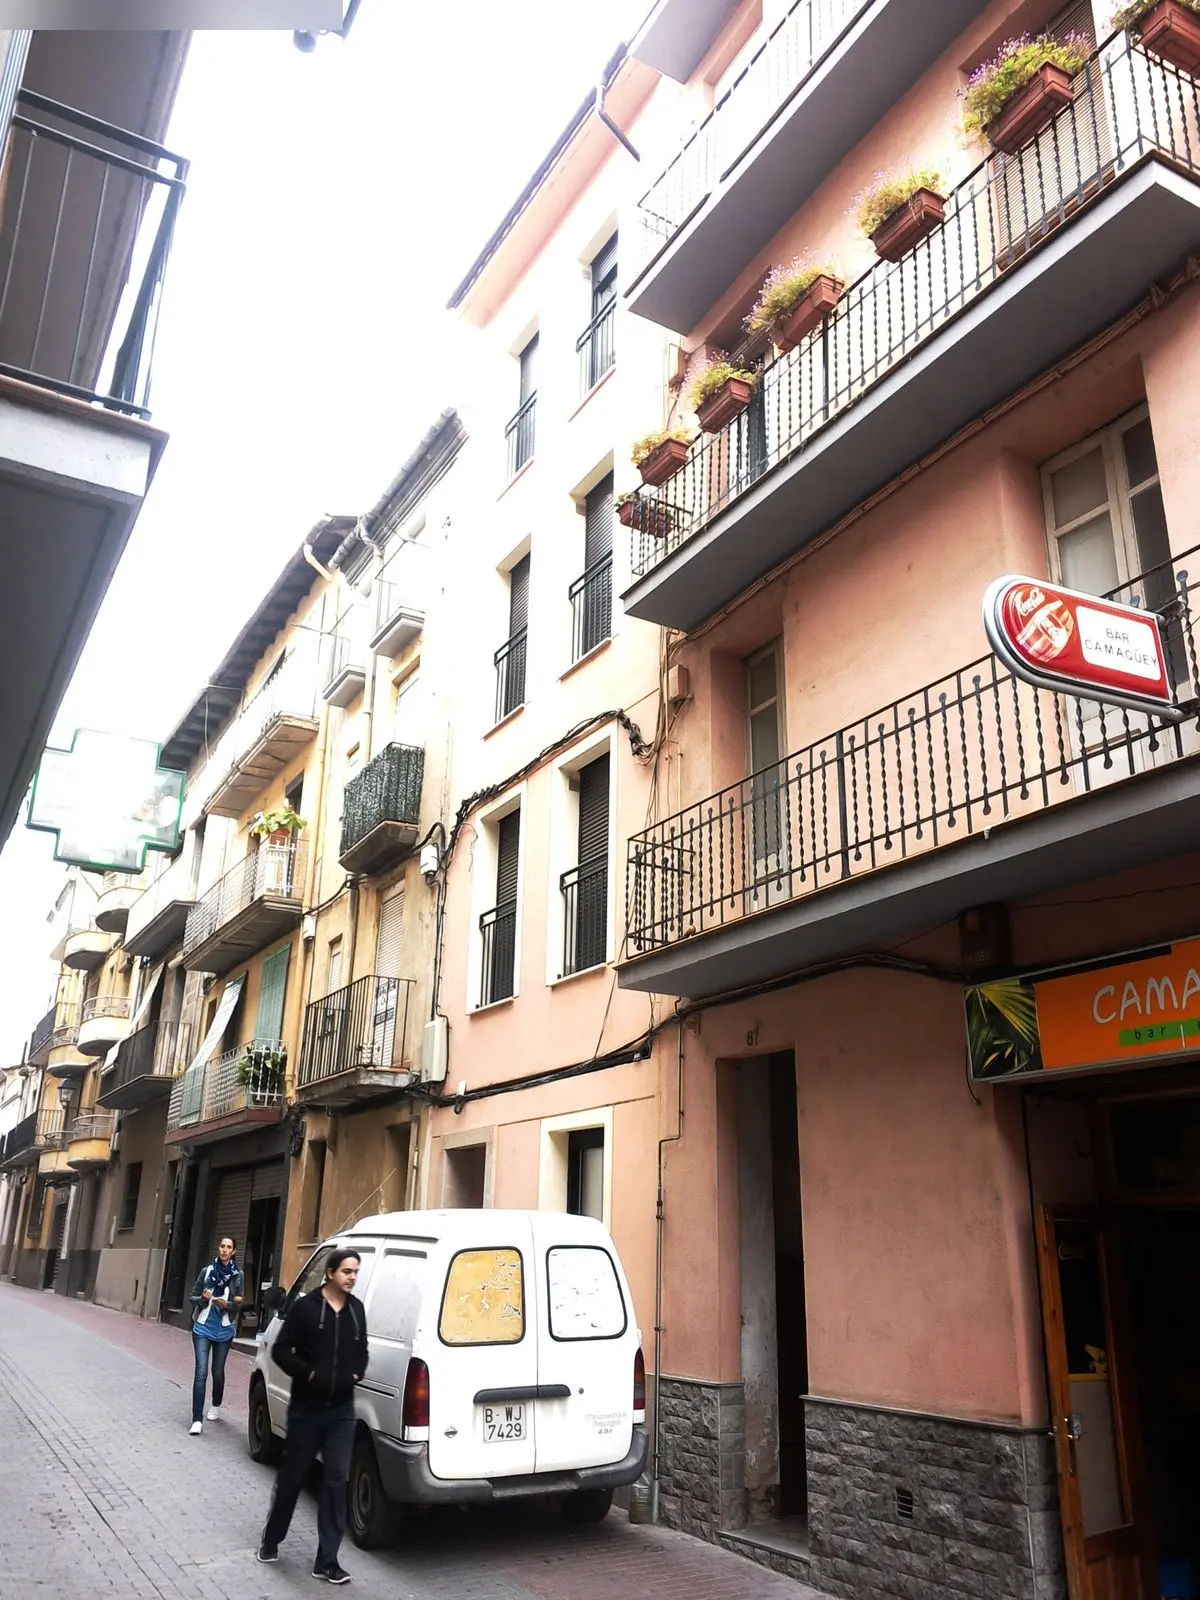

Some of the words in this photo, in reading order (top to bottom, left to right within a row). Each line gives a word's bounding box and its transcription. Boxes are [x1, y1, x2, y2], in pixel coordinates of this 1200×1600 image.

[1105, 628, 1130, 643] BAR
[1084, 639, 1157, 666] CAMAGÜEY
[1093, 968, 1200, 1024] CAMA
[1134, 1025, 1167, 1041] bar
[488, 1422, 522, 1441] 7429
